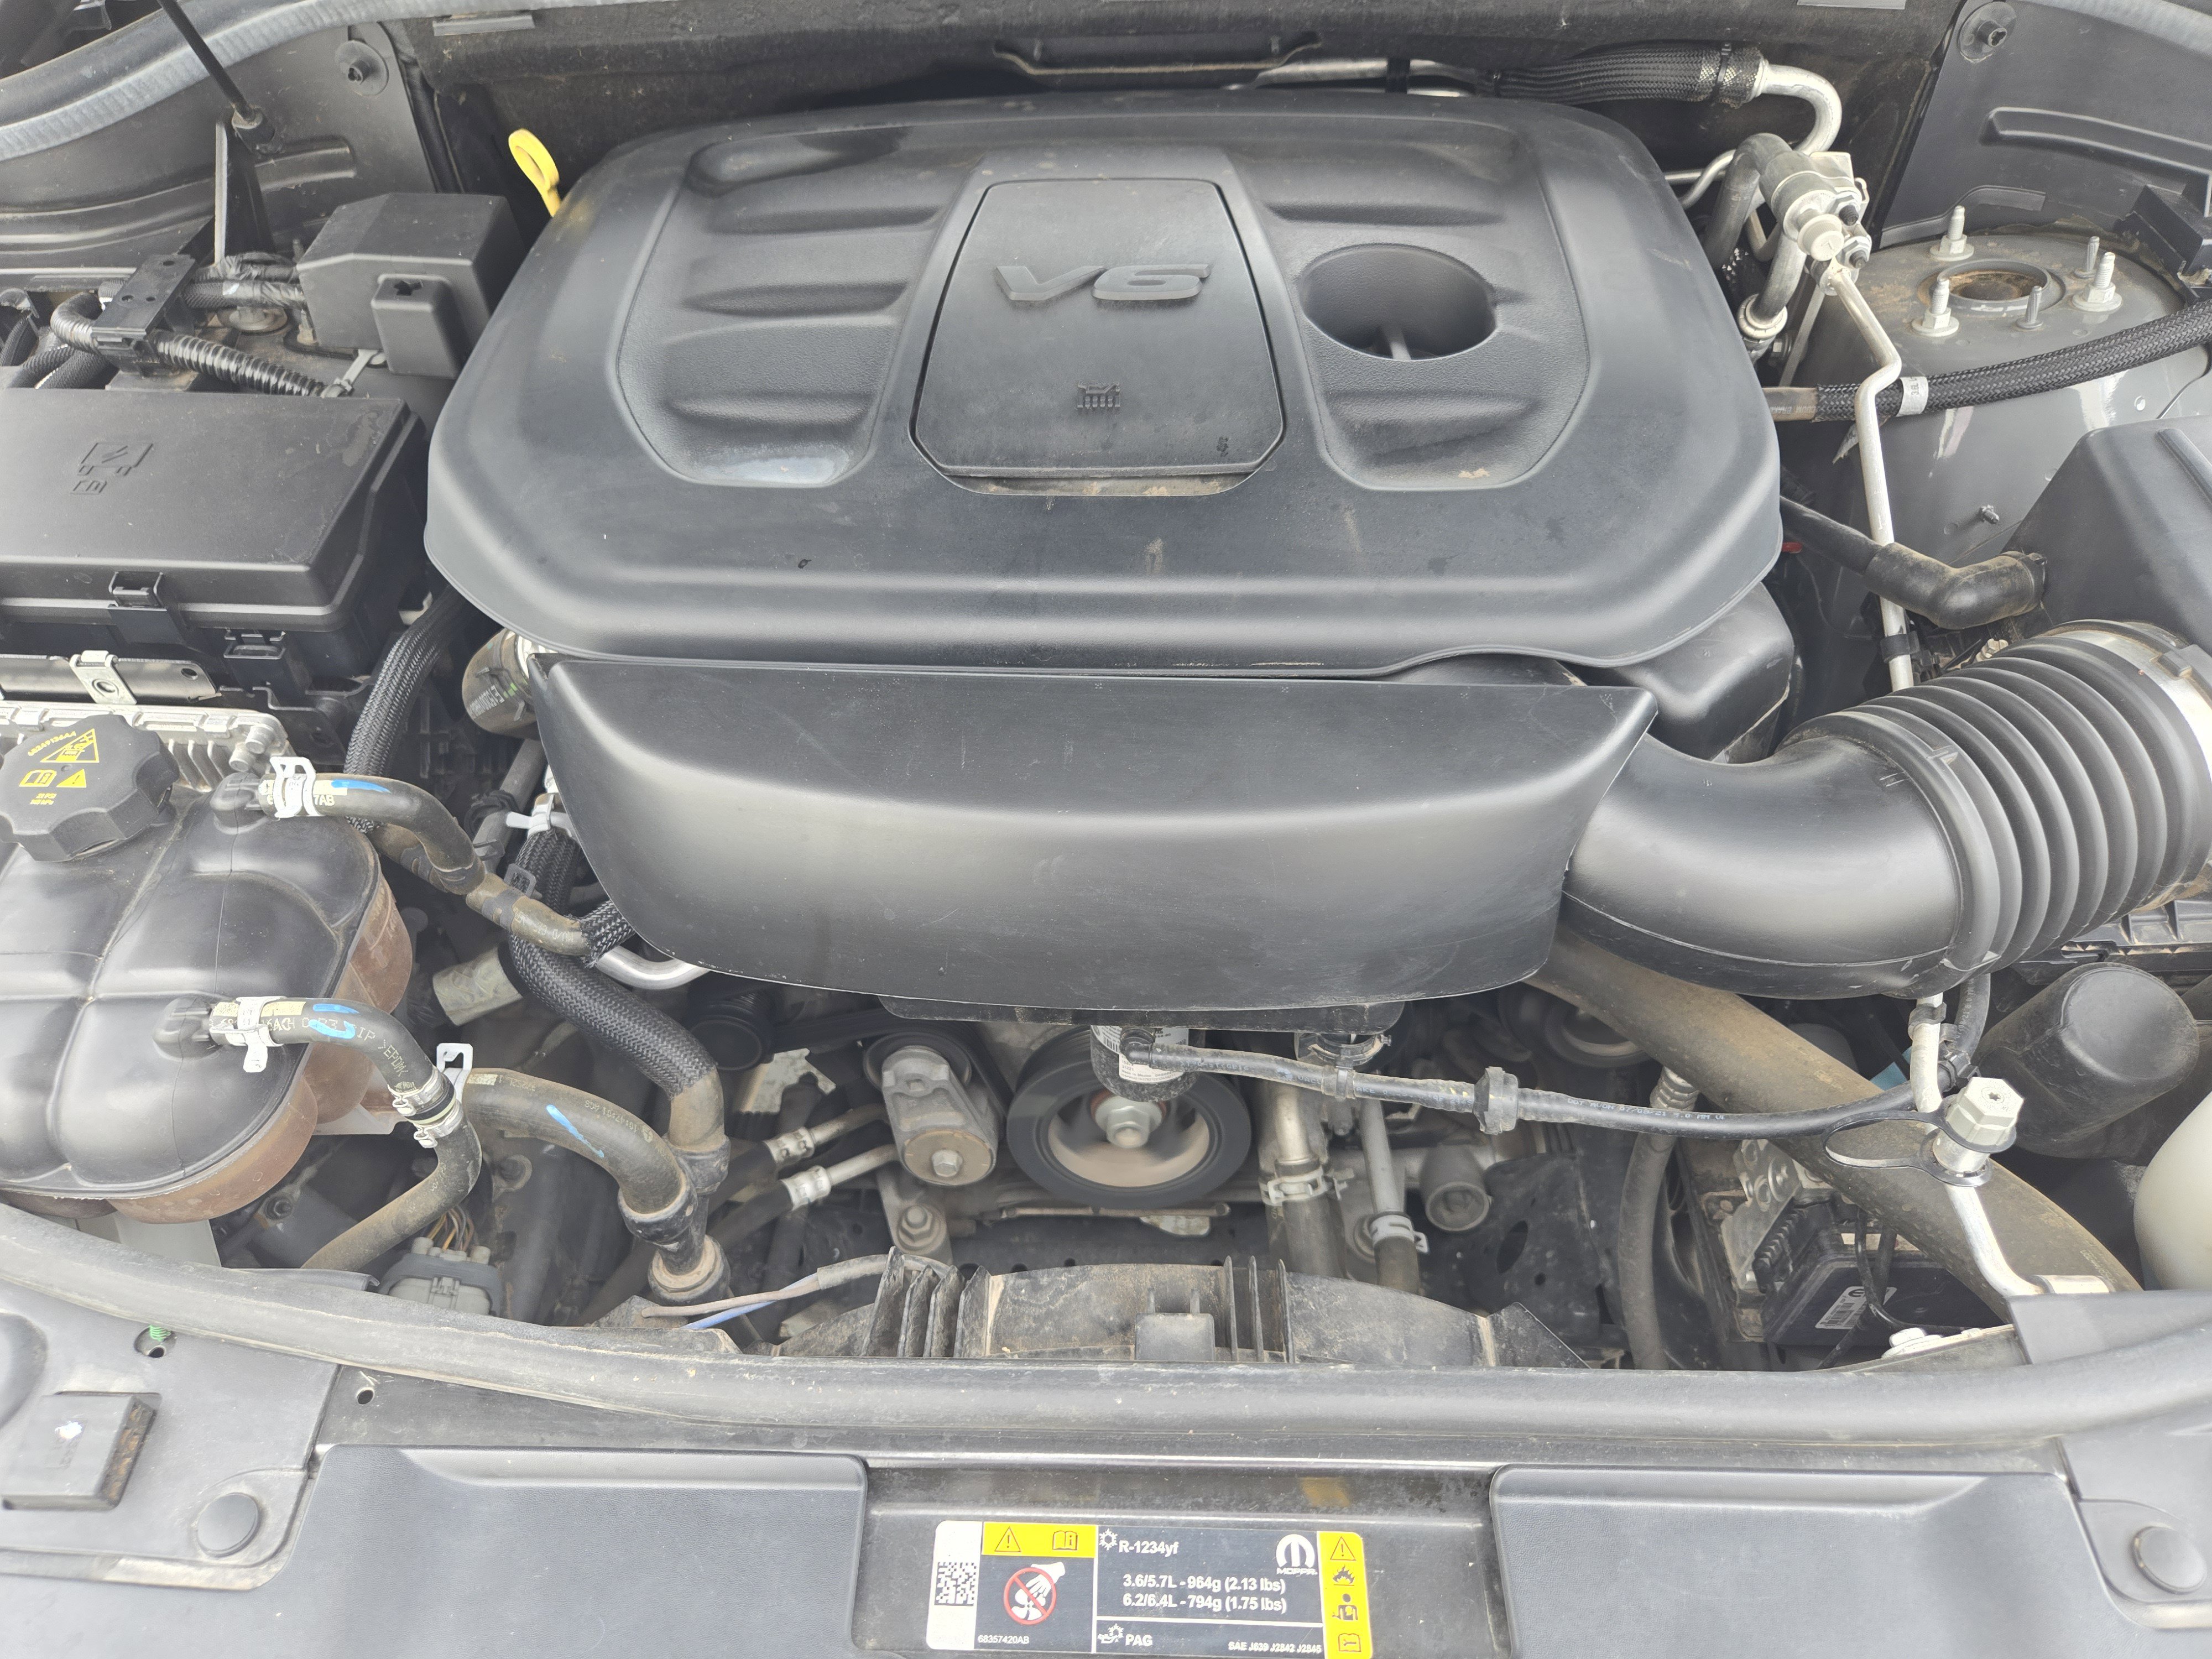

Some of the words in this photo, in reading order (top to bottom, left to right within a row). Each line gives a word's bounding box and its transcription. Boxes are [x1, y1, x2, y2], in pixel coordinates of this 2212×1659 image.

[995, 264, 1212, 301] V6
[1118, 1540, 1179, 1557] R-1234yf
[1123, 1574, 1177, 1588] 3.6/5.7L
[1187, 1575, 1222, 1592] 964g
[1224, 1577, 1257, 1593] (2.13
[1260, 1578, 1286, 1595] lbs)
[1123, 1593, 1177, 1607] 6.2/6.4L
[1187, 1595, 1222, 1612] 794g
[1225, 1596, 1258, 1612] (1.75
[1260, 1597, 1286, 1614] lbs)
[978, 1635, 1030, 1644] 68357420AB
[1125, 1634, 1153, 1647] PAG
[1228, 1641, 1247, 1651] SAE
[1249, 1642, 1269, 1652] J639
[1270, 1643, 1295, 1653] J2842
[1296, 1644, 1322, 1653] J2845
